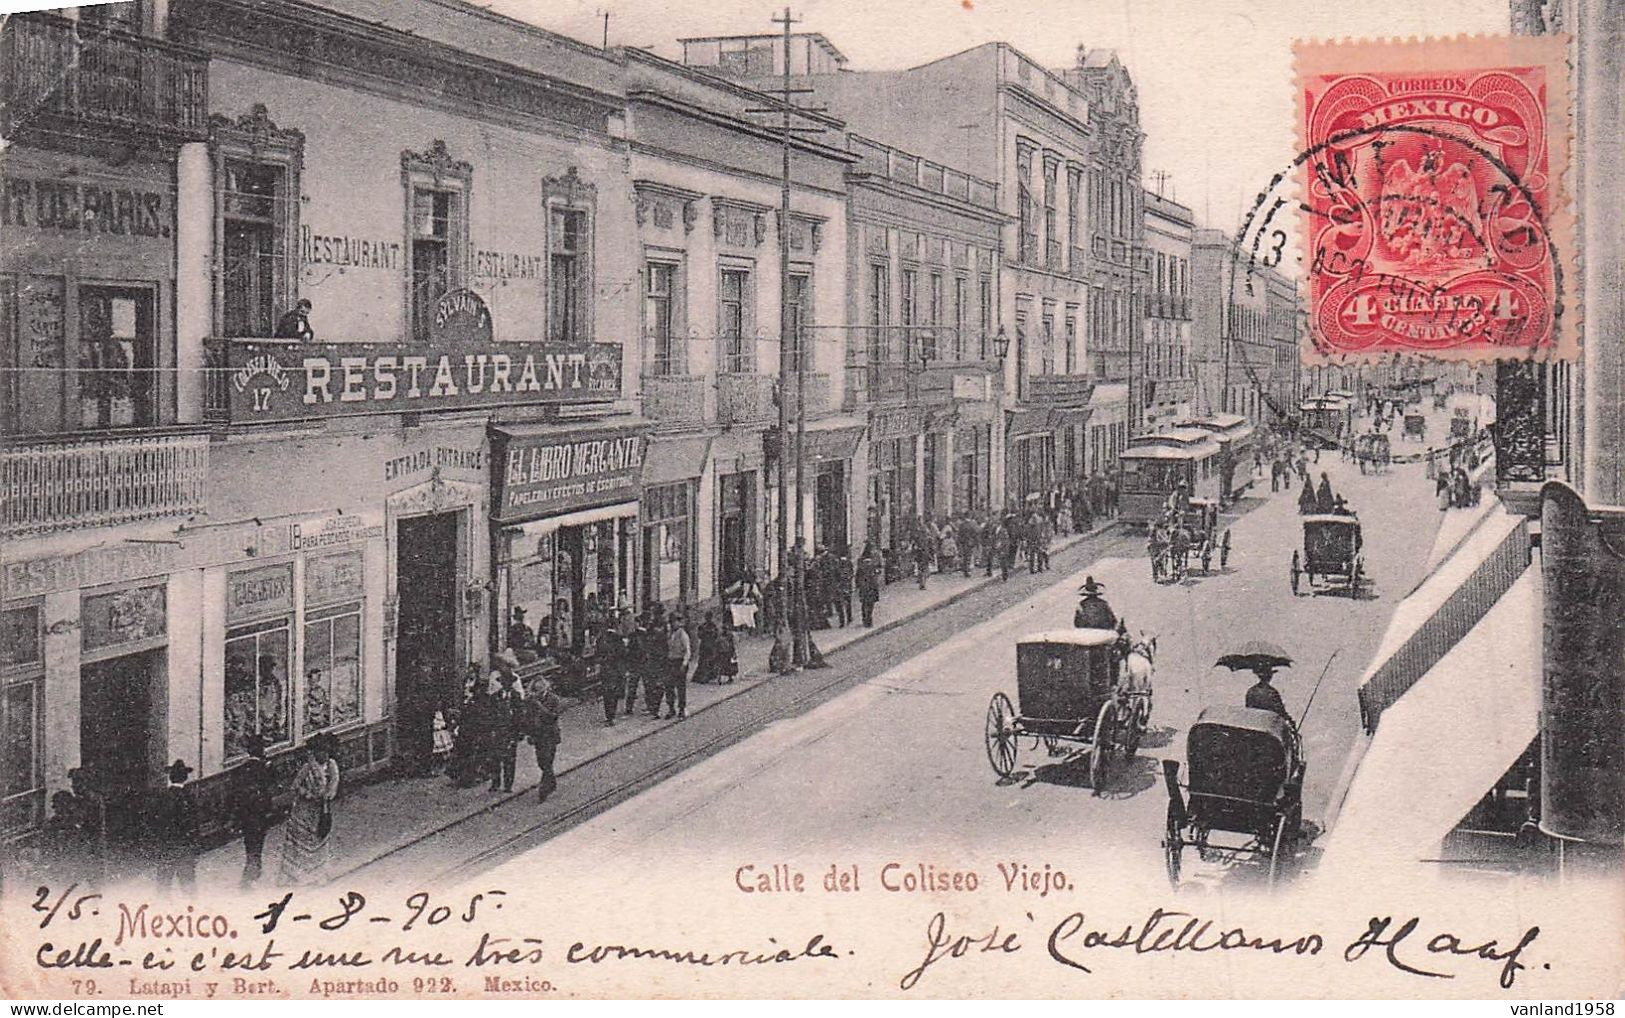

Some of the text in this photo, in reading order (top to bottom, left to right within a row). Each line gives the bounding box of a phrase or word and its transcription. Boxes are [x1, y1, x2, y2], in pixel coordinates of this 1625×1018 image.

[1389, 79, 1465, 94] CORREOS
[1360, 101, 1499, 126] MEXICO
[302, 223, 399, 269] RESTAURANT
[436, 295, 486, 328] SYLVAIN'S
[1342, 294, 1379, 326] 4
[1486, 288, 1520, 320] 4
[303, 353, 586, 404] RESTAURANT
[253, 388, 271, 411] 17
[385, 447, 482, 481] ENTRADA ENTRANCE
[508, 437, 641, 486] EL LIBRO MERCANTIL
